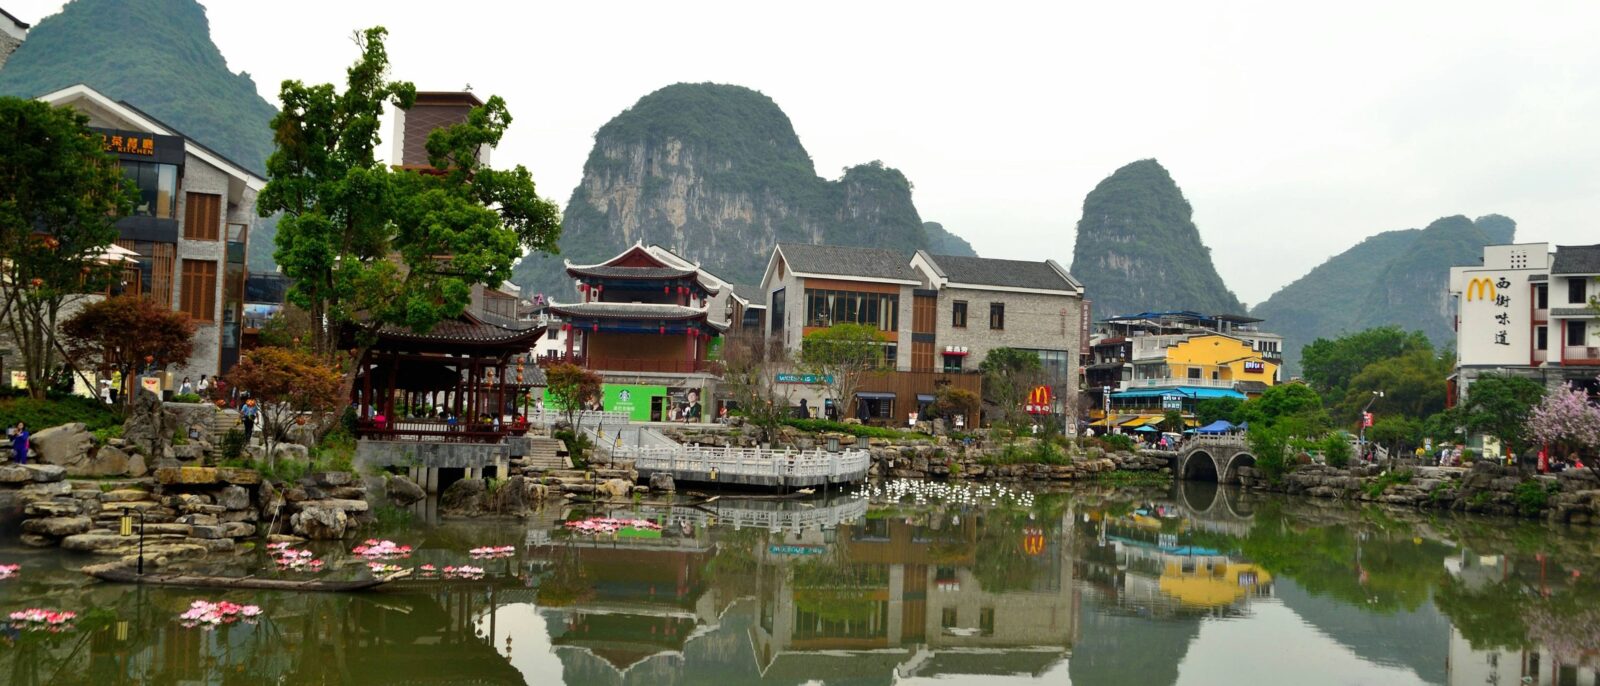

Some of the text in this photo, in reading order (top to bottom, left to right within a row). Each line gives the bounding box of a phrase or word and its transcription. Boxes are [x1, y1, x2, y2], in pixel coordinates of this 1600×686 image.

[117, 147, 153, 155] KITCHEN
[1495, 277, 1511, 346] 西街味道
